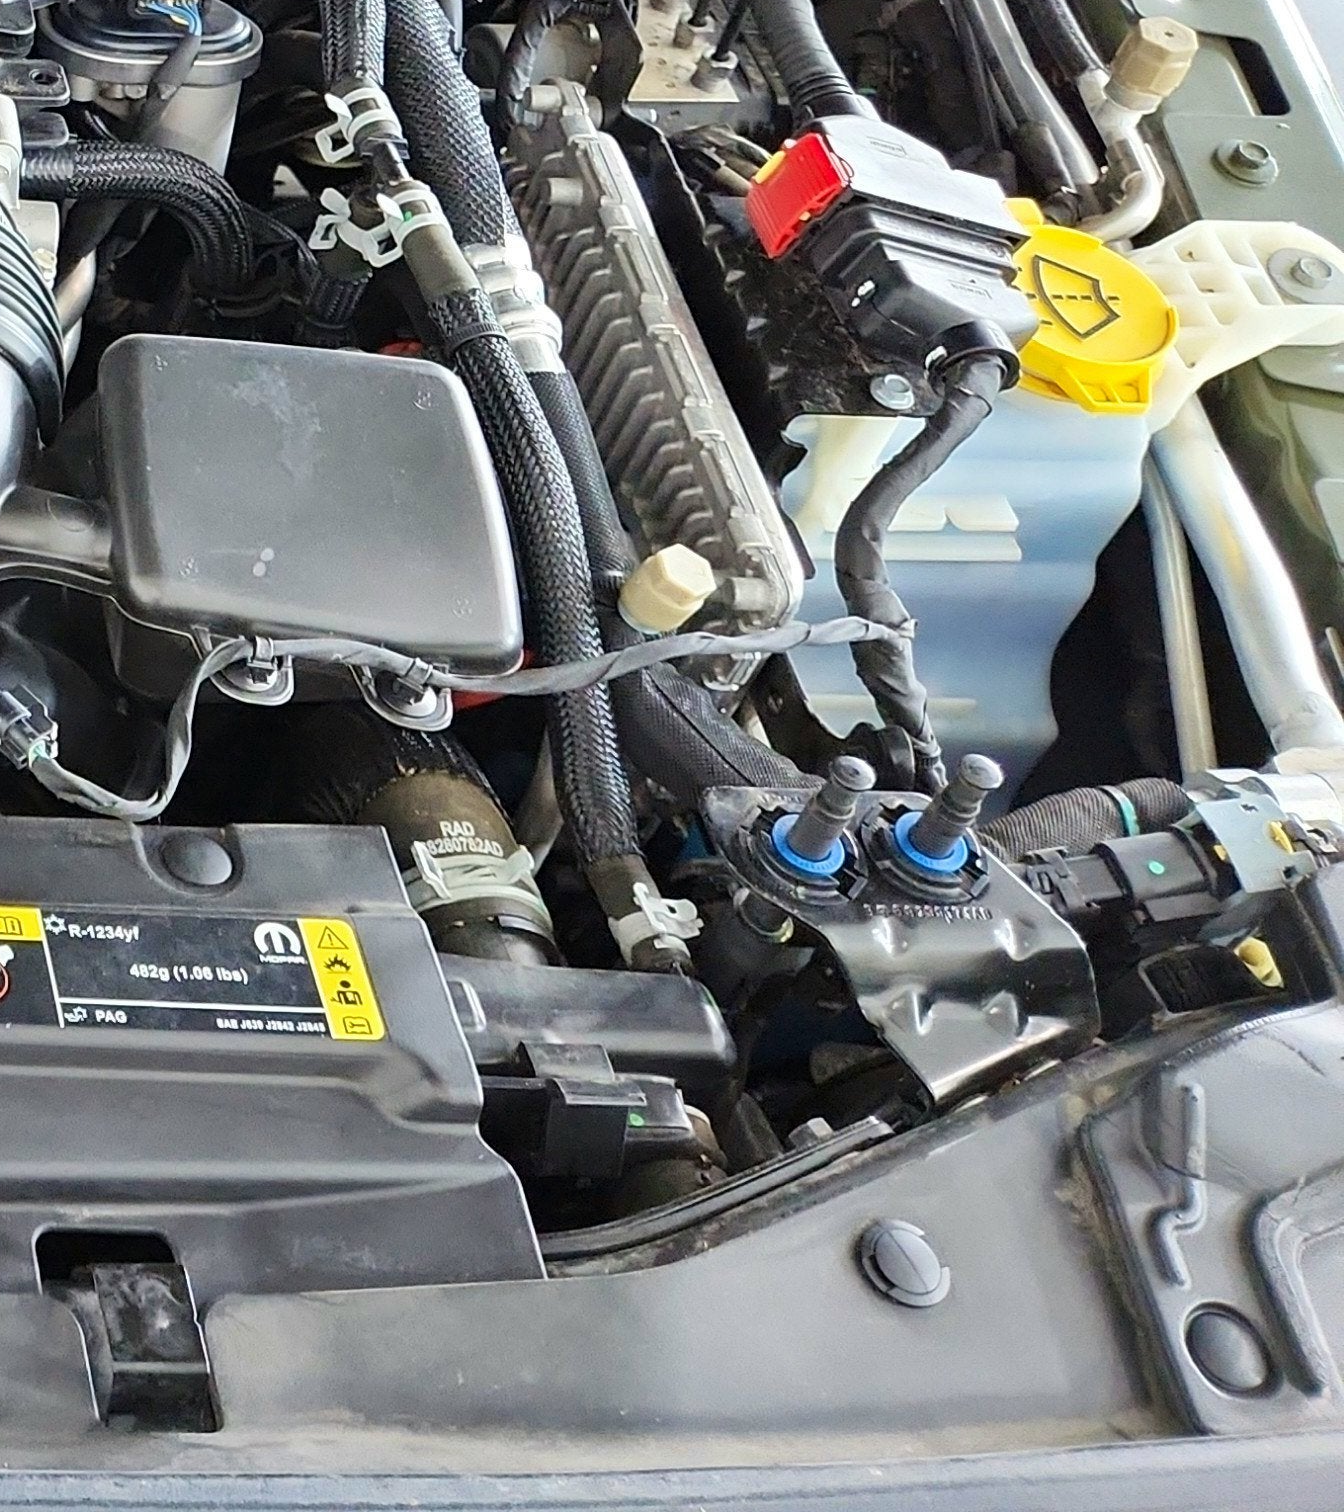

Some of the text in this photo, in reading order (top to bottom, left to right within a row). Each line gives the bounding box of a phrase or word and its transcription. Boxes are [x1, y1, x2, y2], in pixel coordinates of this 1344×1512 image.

[439, 820, 476, 837] RAD
[67, 924, 140, 943] R-1234yf
[129, 963, 170, 983] 482g
[215, 967, 249, 985] lbs)
[95, 1009, 128, 1024] PAG
